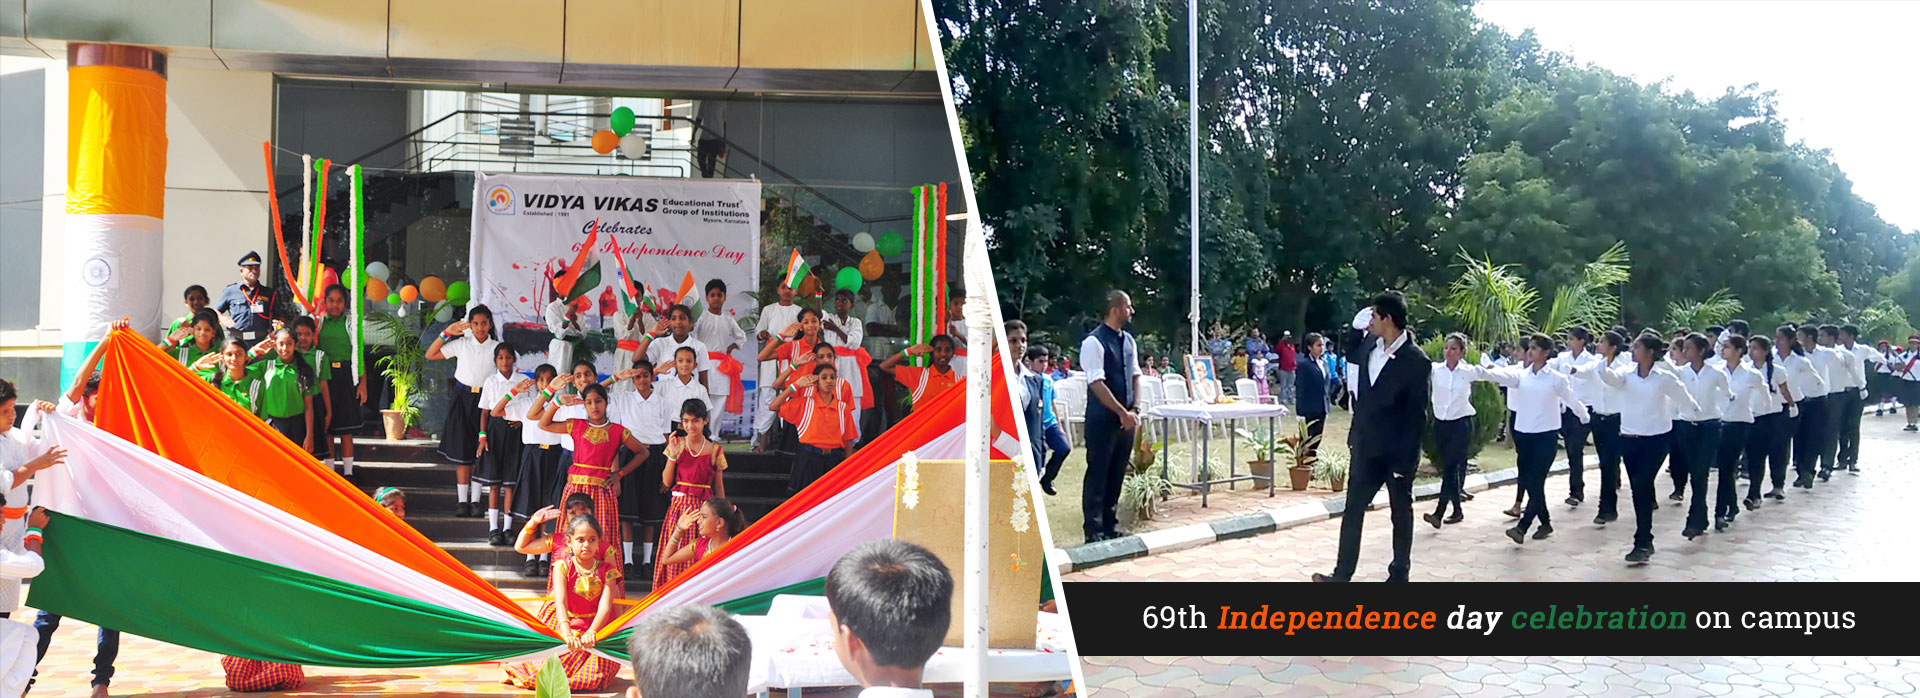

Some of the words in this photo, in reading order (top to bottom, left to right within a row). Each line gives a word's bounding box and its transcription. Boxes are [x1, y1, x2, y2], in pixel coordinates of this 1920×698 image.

[524, 193, 585, 210] VIDYA
[594, 196, 659, 212] VIKAS
[662, 199, 715, 207] Educational
[717, 200, 740, 208] Trust
[662, 207, 688, 216] Group
[701, 209, 750, 218] Institutions
[712, 244, 746, 265] Day
